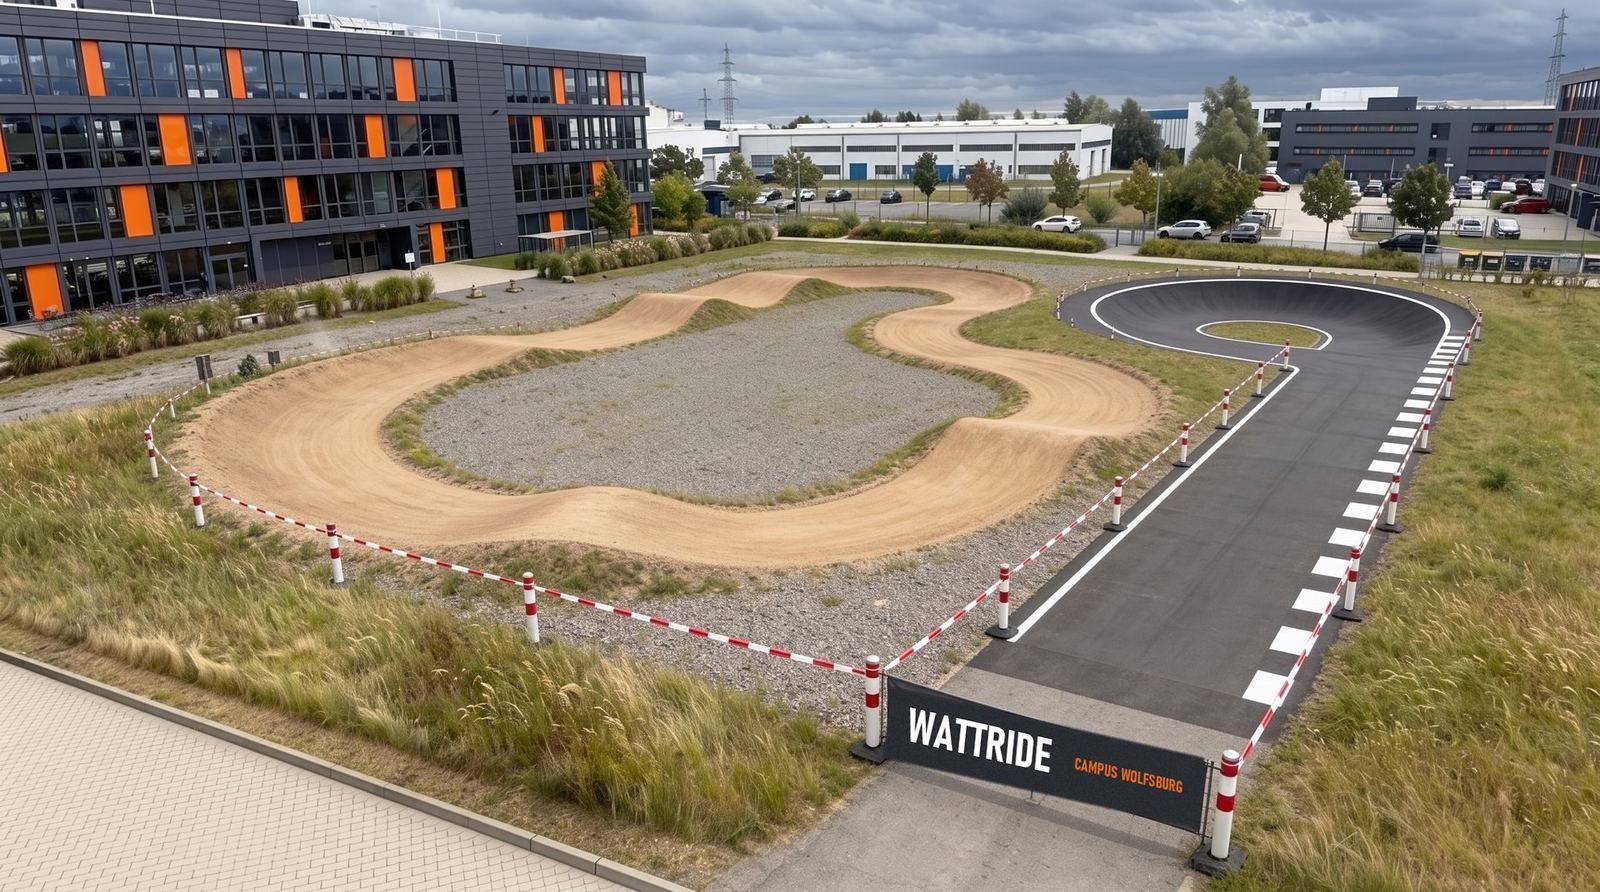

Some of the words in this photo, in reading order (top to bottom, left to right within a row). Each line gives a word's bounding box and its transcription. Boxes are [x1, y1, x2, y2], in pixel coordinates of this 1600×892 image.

[909, 707, 1053, 774] WATTRIDE
[1074, 757, 1118, 779] CAMPUS
[1121, 767, 1184, 794] WOLFSBURG
